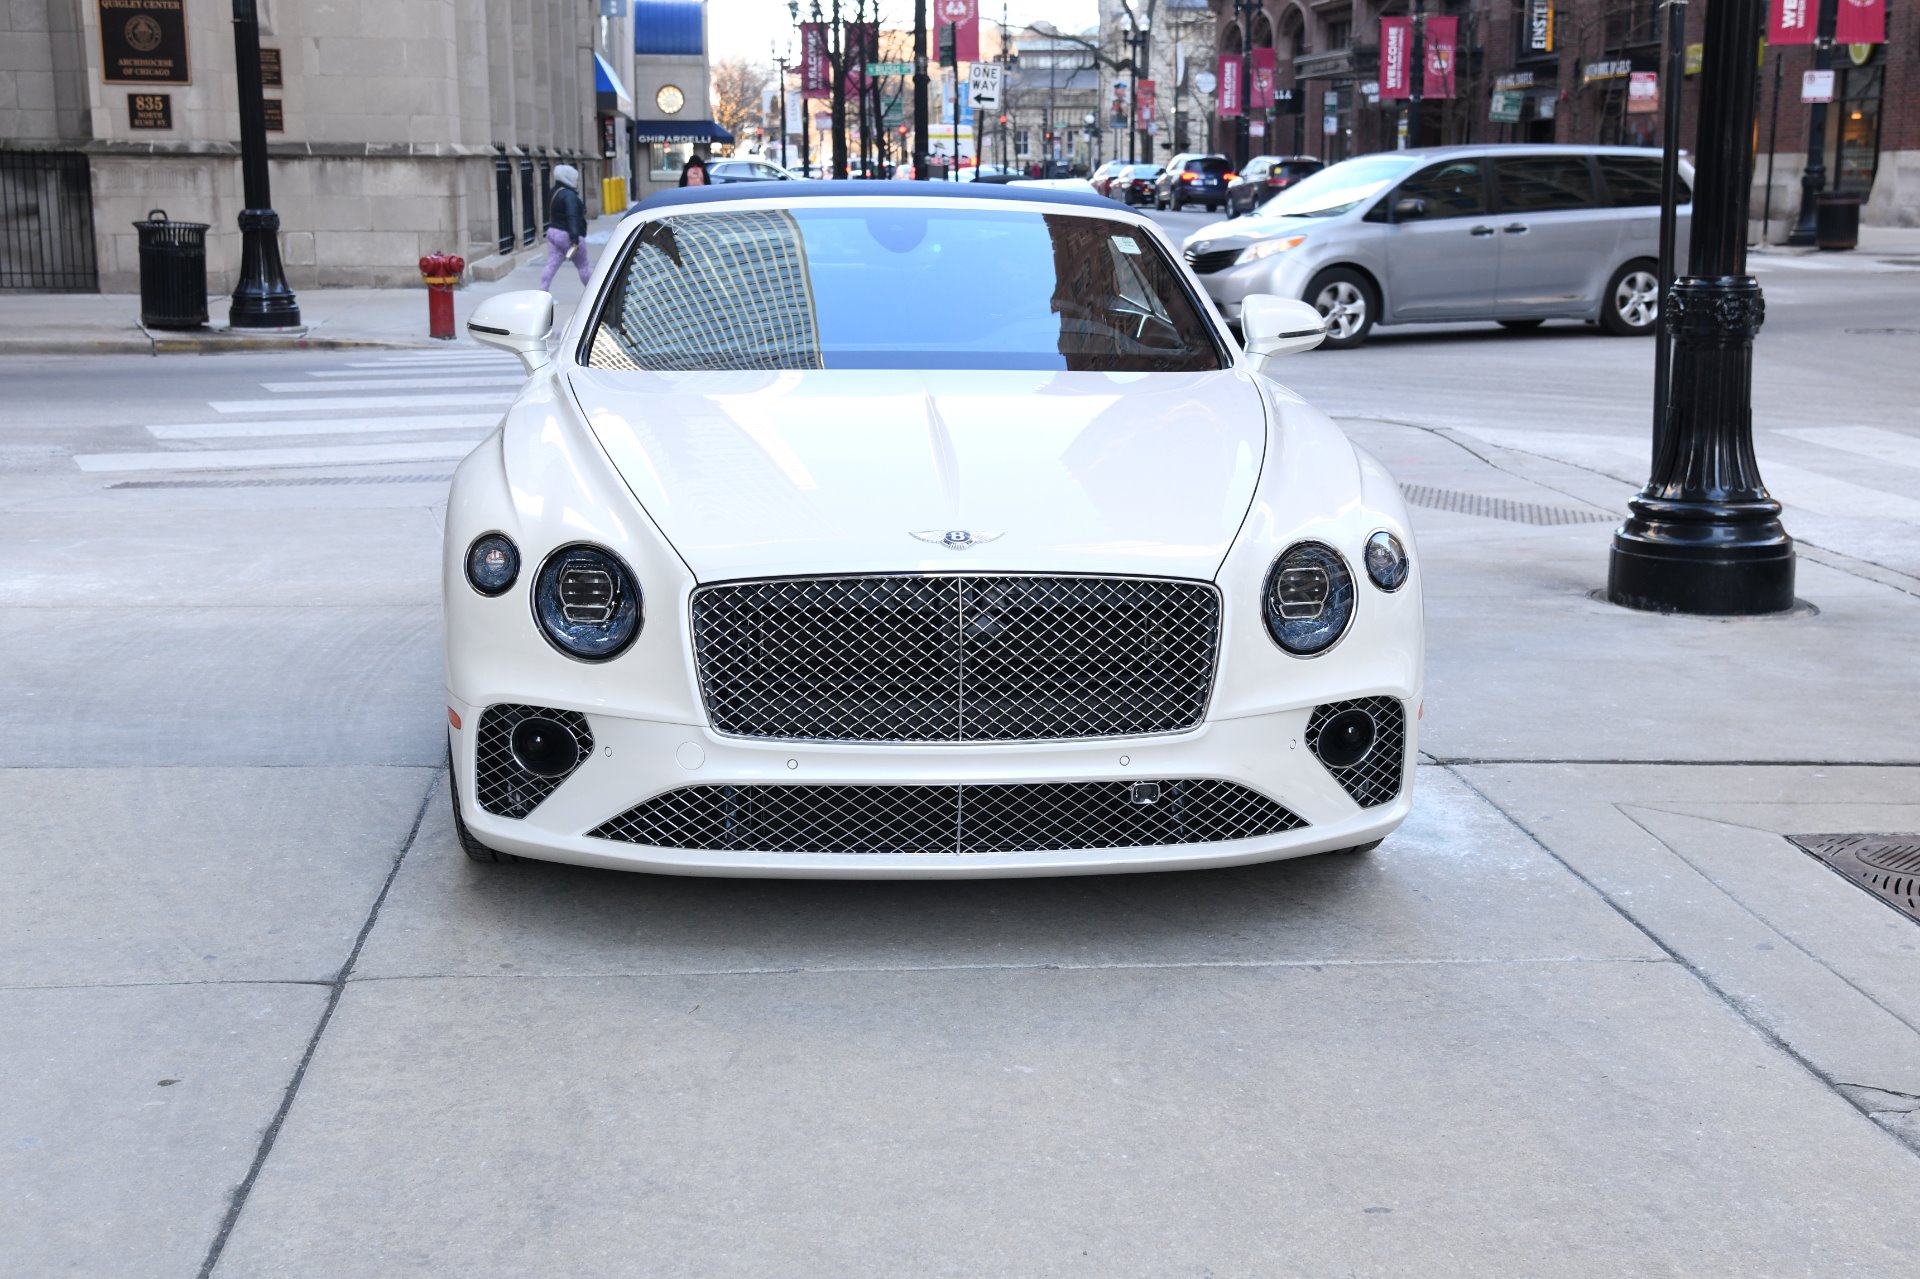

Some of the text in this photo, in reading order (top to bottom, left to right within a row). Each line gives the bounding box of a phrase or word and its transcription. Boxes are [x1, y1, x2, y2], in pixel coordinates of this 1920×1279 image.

[101, 0, 180, 9] QUIGLEY CENTER
[1387, 27, 1398, 89] WELCOME
[122, 67, 171, 76] OF CHICAGO
[876, 64, 901, 76] RUSH
[973, 67, 998, 80] ONE
[972, 81, 998, 92] WAY
[1223, 62, 1232, 109] WELCOME
[136, 96, 164, 111] 835
[137, 111, 163, 119] NORTH
[638, 135, 711, 144] GHIRARDELLI
